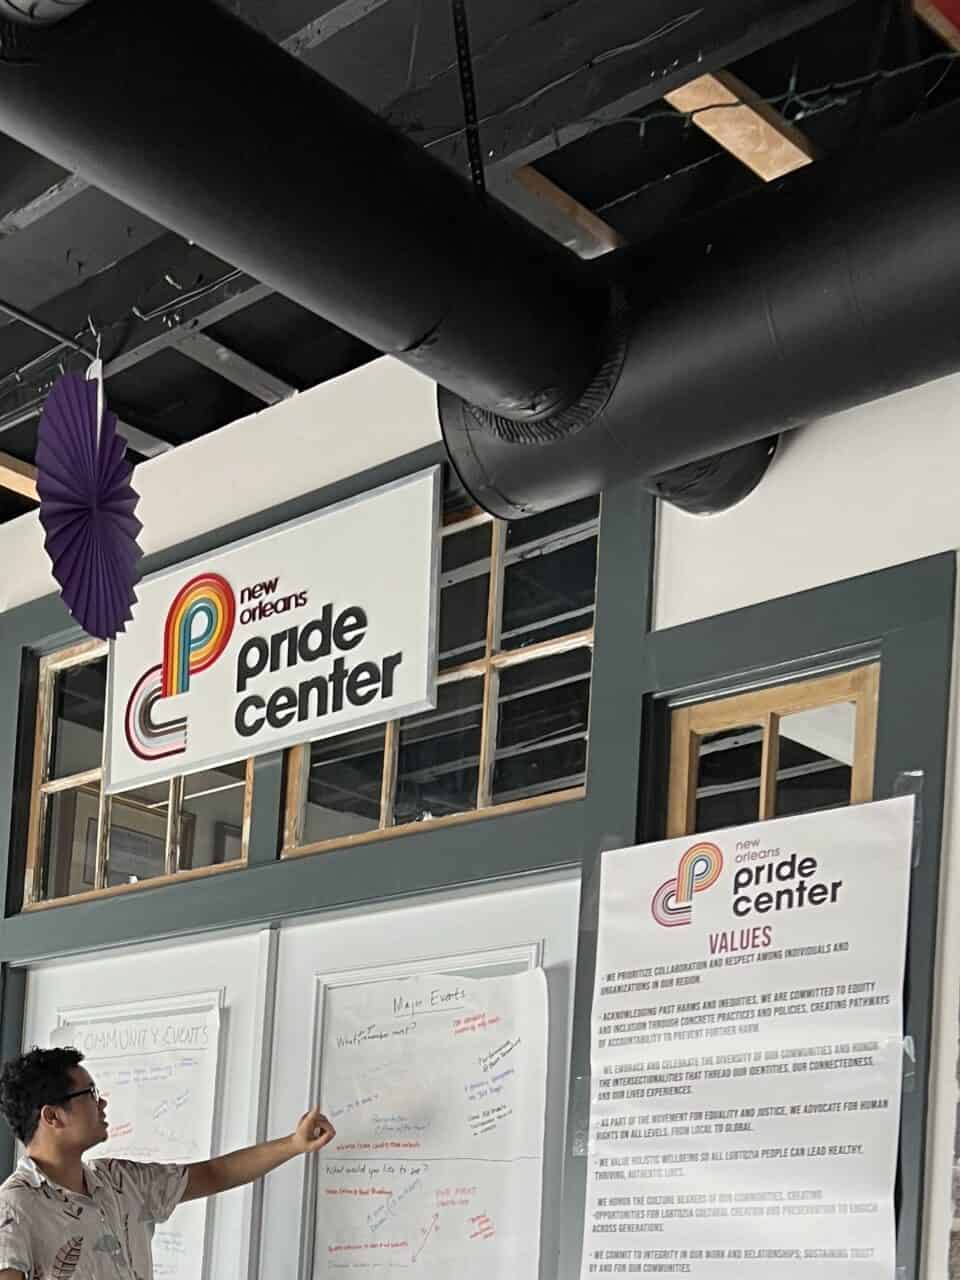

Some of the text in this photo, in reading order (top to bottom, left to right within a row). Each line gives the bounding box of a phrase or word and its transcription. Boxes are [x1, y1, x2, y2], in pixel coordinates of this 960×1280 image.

[240, 576, 279, 604] new
[239, 588, 308, 625] orleans
[236, 602, 368, 693] pride
[234, 651, 403, 737] center
[736, 839, 760, 850] new
[736, 848, 780, 863] orleans
[734, 854, 818, 895] pride
[732, 880, 842, 917] center
[709, 926, 772, 954] VALUES
[607, 942, 848, 982] WE PRIORITIZE COLLABORATION AND RESPECT AMONG INDIVIDUALS AND
[600, 978, 674, 996] ORGANIZATIONS IN OUR
[393, 995, 422, 1016] Major
[603, 982, 876, 1021] ACKNOWLEDGING PAST HARMS AND WE ARE COMMITTED TO EQUITY
[600, 1079, 610, 1088] THE
[612, 1072, 684, 1086] INTERSECTIONALITIES
[686, 1071, 702, 1080] THAT
[704, 1068, 732, 1080] THREAD
[732, 1067, 747, 1077] OUR
[792, 1062, 808, 1072] OUR
[610, 1117, 626, 1127] PART
[628, 1116, 637, 1125] OF
[639, 1114, 649, 1124] THE
[652, 1112, 688, 1123] MOVEMENT
[690, 1112, 702, 1120] FOR
[704, 1109, 738, 1120] EQUALITY
[740, 1108, 755, 1118] AND
[790, 1104, 800, 1114] WE
[803, 1102, 842, 1114] ADVOCATE
[843, 1101, 858, 1111] FOR
[860, 1099, 888, 1110] HUMAN
[592, 1224, 617, 1232] ACROSS
